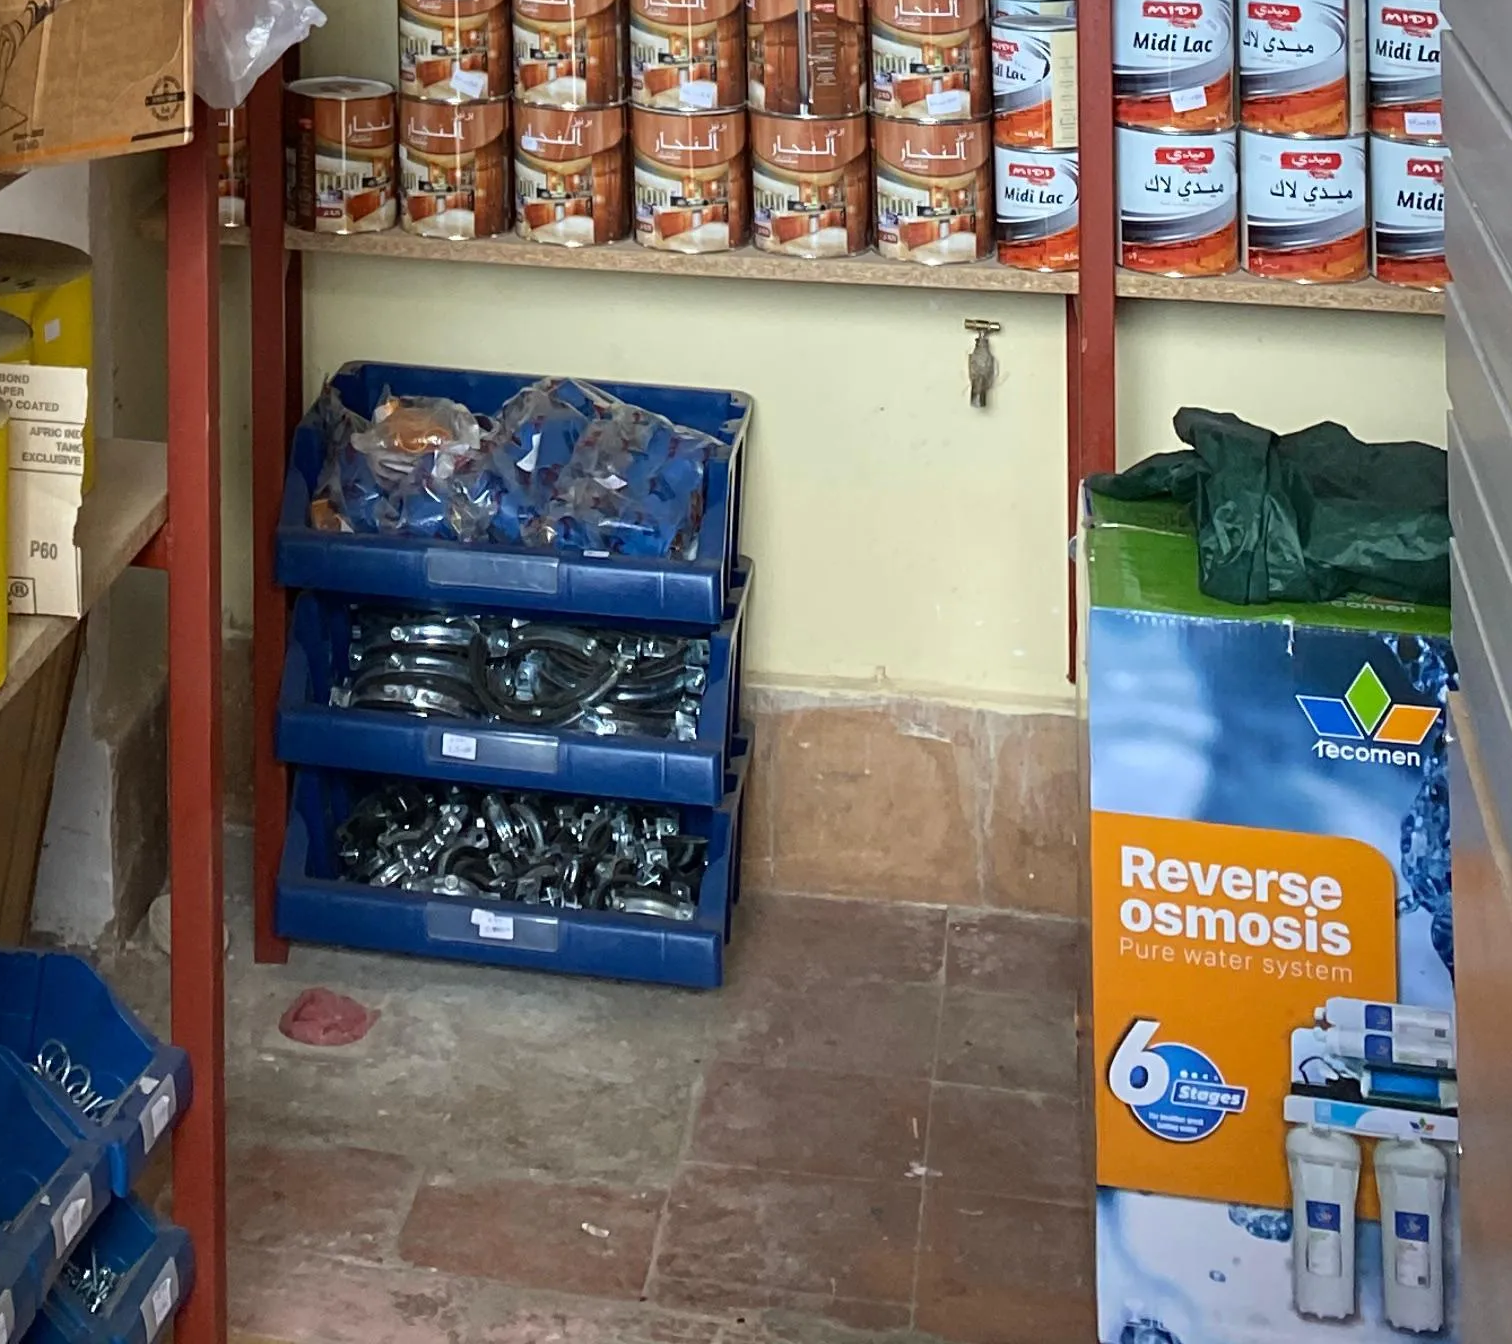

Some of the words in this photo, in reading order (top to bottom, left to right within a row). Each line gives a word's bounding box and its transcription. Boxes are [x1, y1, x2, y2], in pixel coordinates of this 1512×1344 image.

[1147, 4, 1198, 16] MIDI
[1383, 13, 1433, 25] MIDI
[1133, 32, 1178, 51] Midi
[1182, 35, 1213, 54] Lac
[1375, 38, 1411, 60] Midi
[1012, 167, 1053, 177] MIDI
[1005, 186, 1035, 203] Midi
[1039, 187, 1064, 205] Lac
[1396, 191, 1444, 212] Midi
[0, 372, 30, 384] BOND
[15, 401, 59, 413] COATED
[29, 426, 63, 438] AFRIC
[21, 452, 81, 467] EXCLUSIVE
[30, 540, 58, 561] P60
[1311, 740, 1420, 768] Tecomen
[1121, 845, 1343, 910] Reverse
[1121, 898, 1352, 956] osmosis
[1119, 937, 1175, 964] Pure
[1184, 947, 1253, 972] water
[1262, 955, 1353, 985] system
[1109, 1019, 1170, 1107] 6
[1178, 1085, 1241, 1106] Stages
